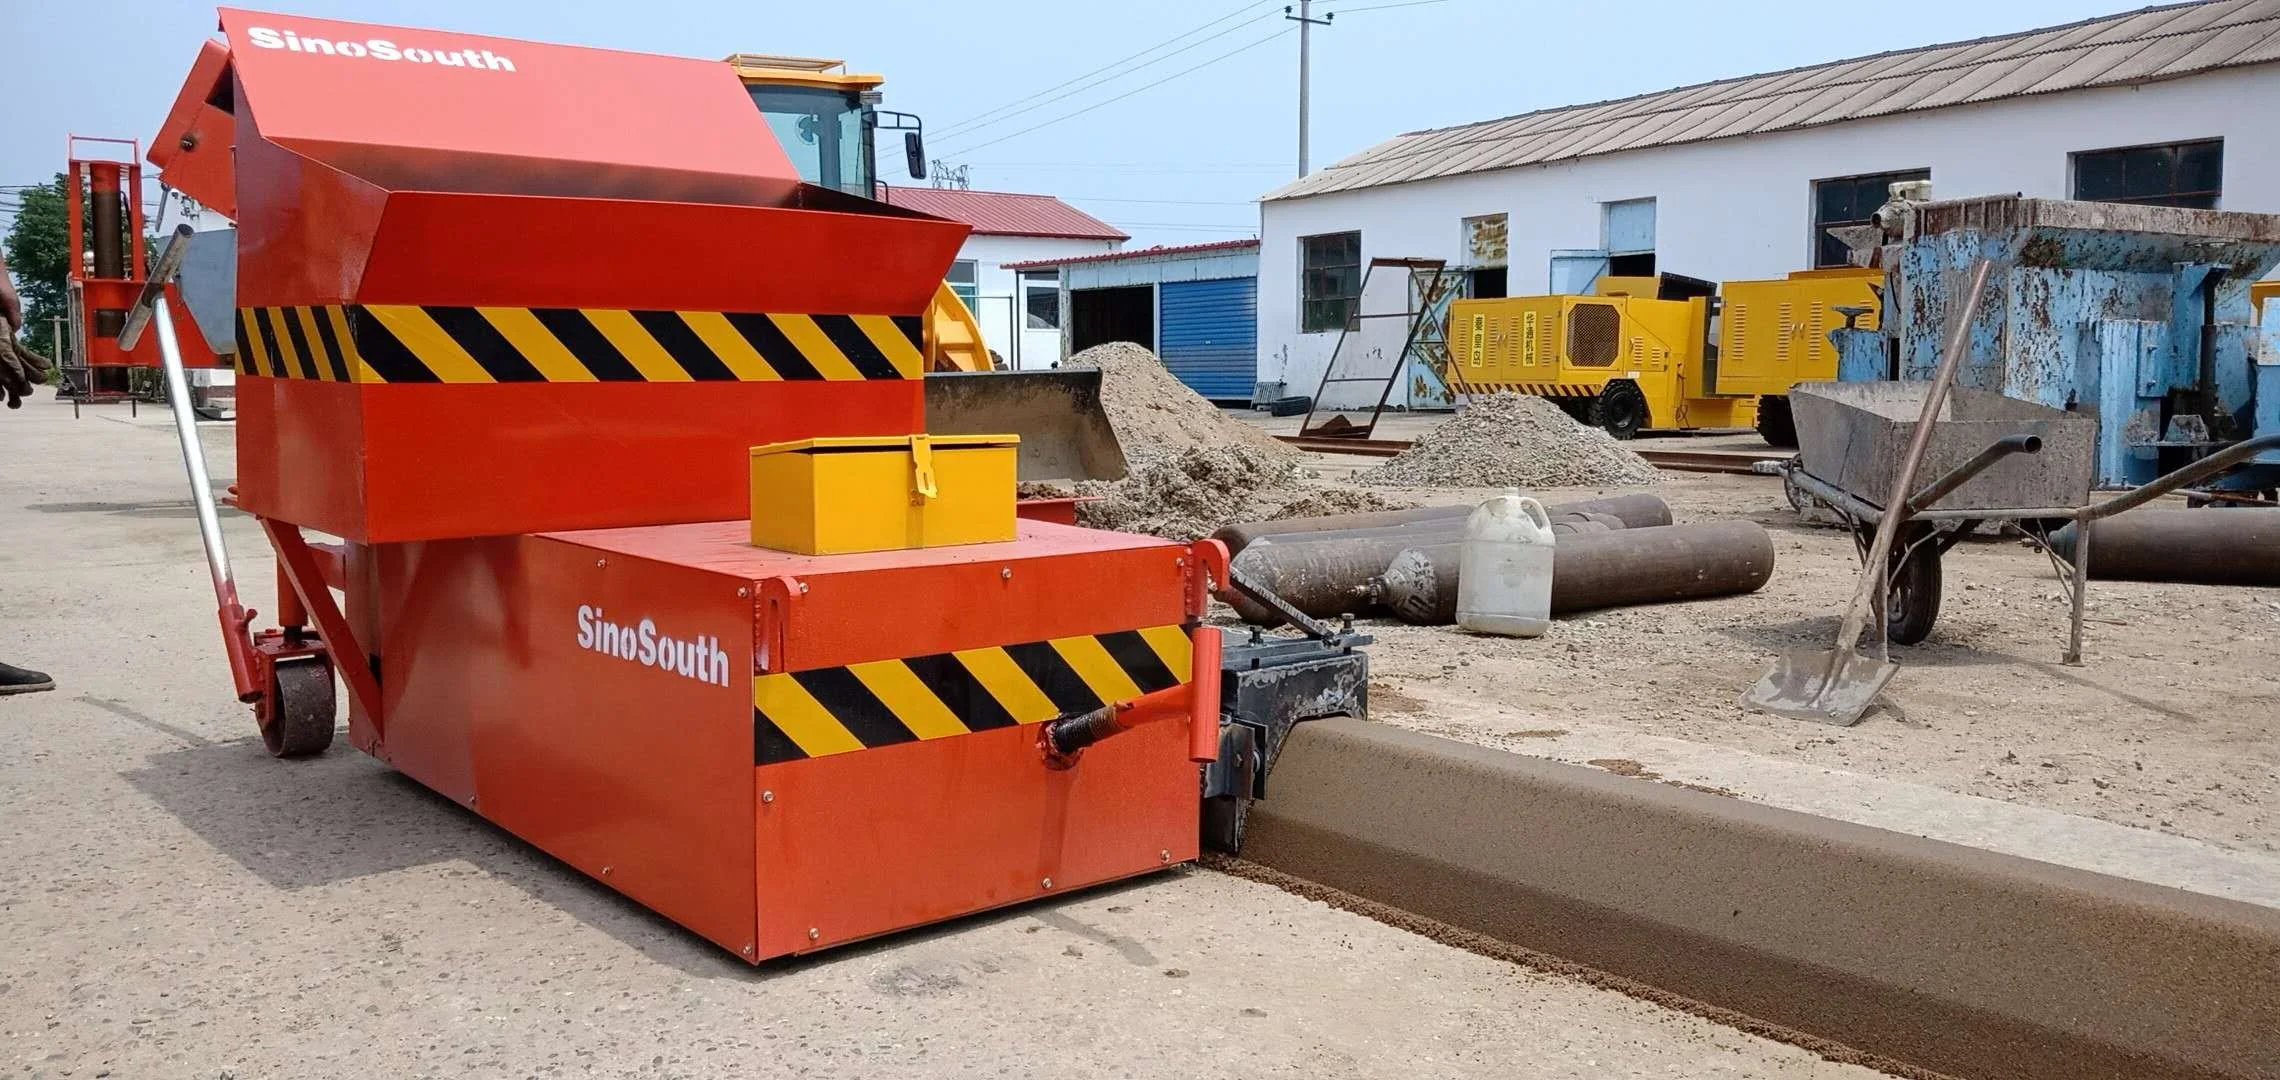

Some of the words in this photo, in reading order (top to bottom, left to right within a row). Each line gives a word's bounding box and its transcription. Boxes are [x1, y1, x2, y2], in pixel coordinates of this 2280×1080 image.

[248, 27, 517, 72] SinoSouth
[1525, 313, 1535, 365] 华通机械
[577, 604, 729, 688] SinoSouth
